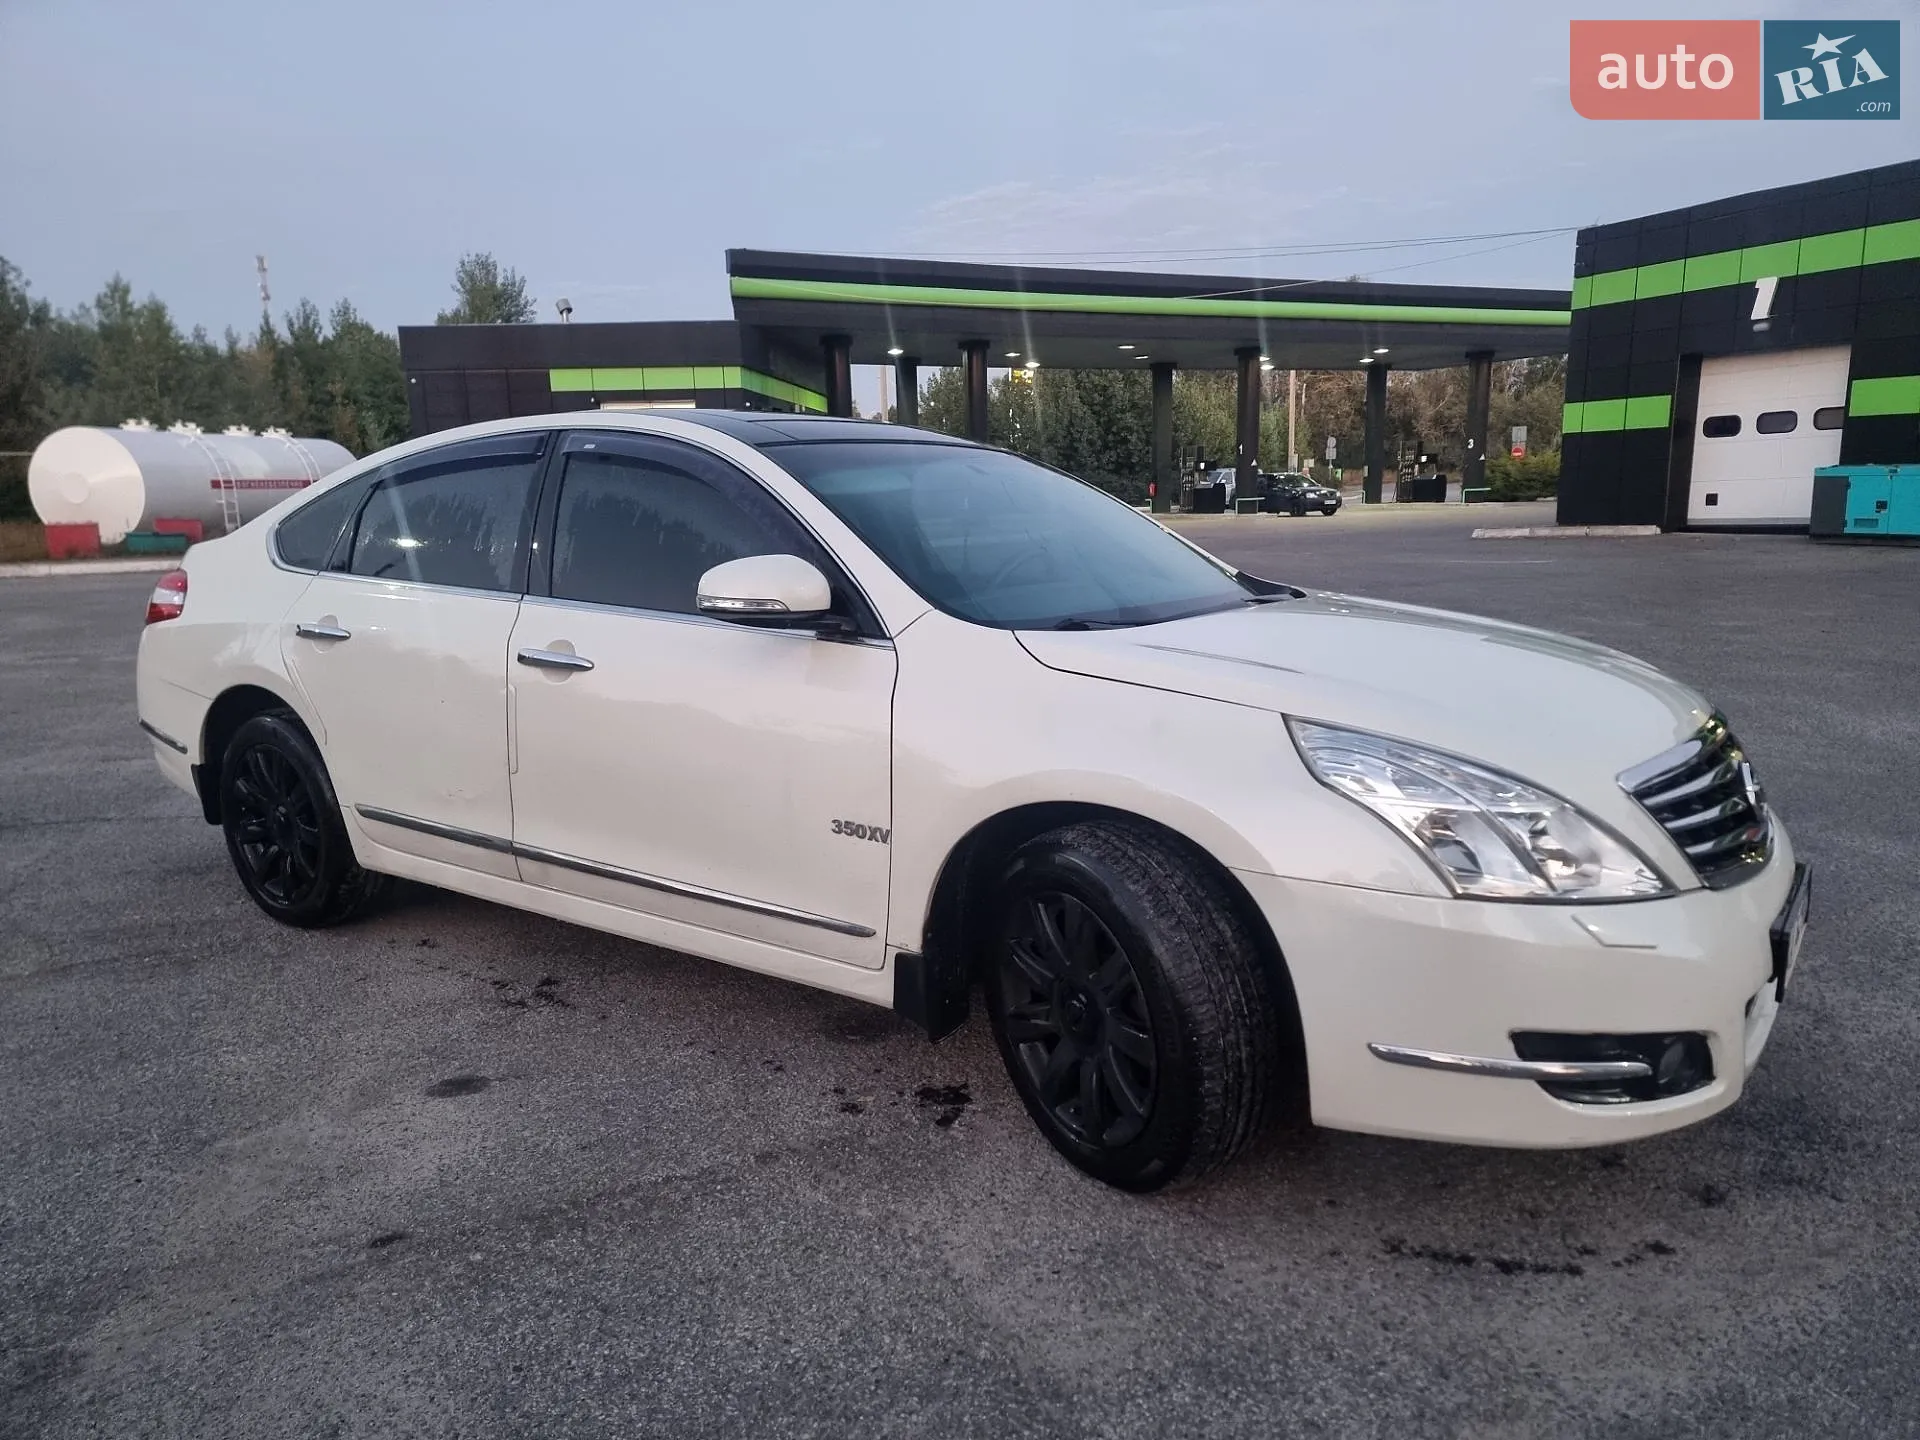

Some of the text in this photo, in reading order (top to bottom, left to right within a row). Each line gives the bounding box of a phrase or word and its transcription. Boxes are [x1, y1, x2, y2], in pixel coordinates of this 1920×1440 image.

[1750, 276, 1779, 321] 1
[1238, 443, 1244, 455] 1
[1467, 438, 1475, 450] 3
[831, 819, 891, 846] 350XV
